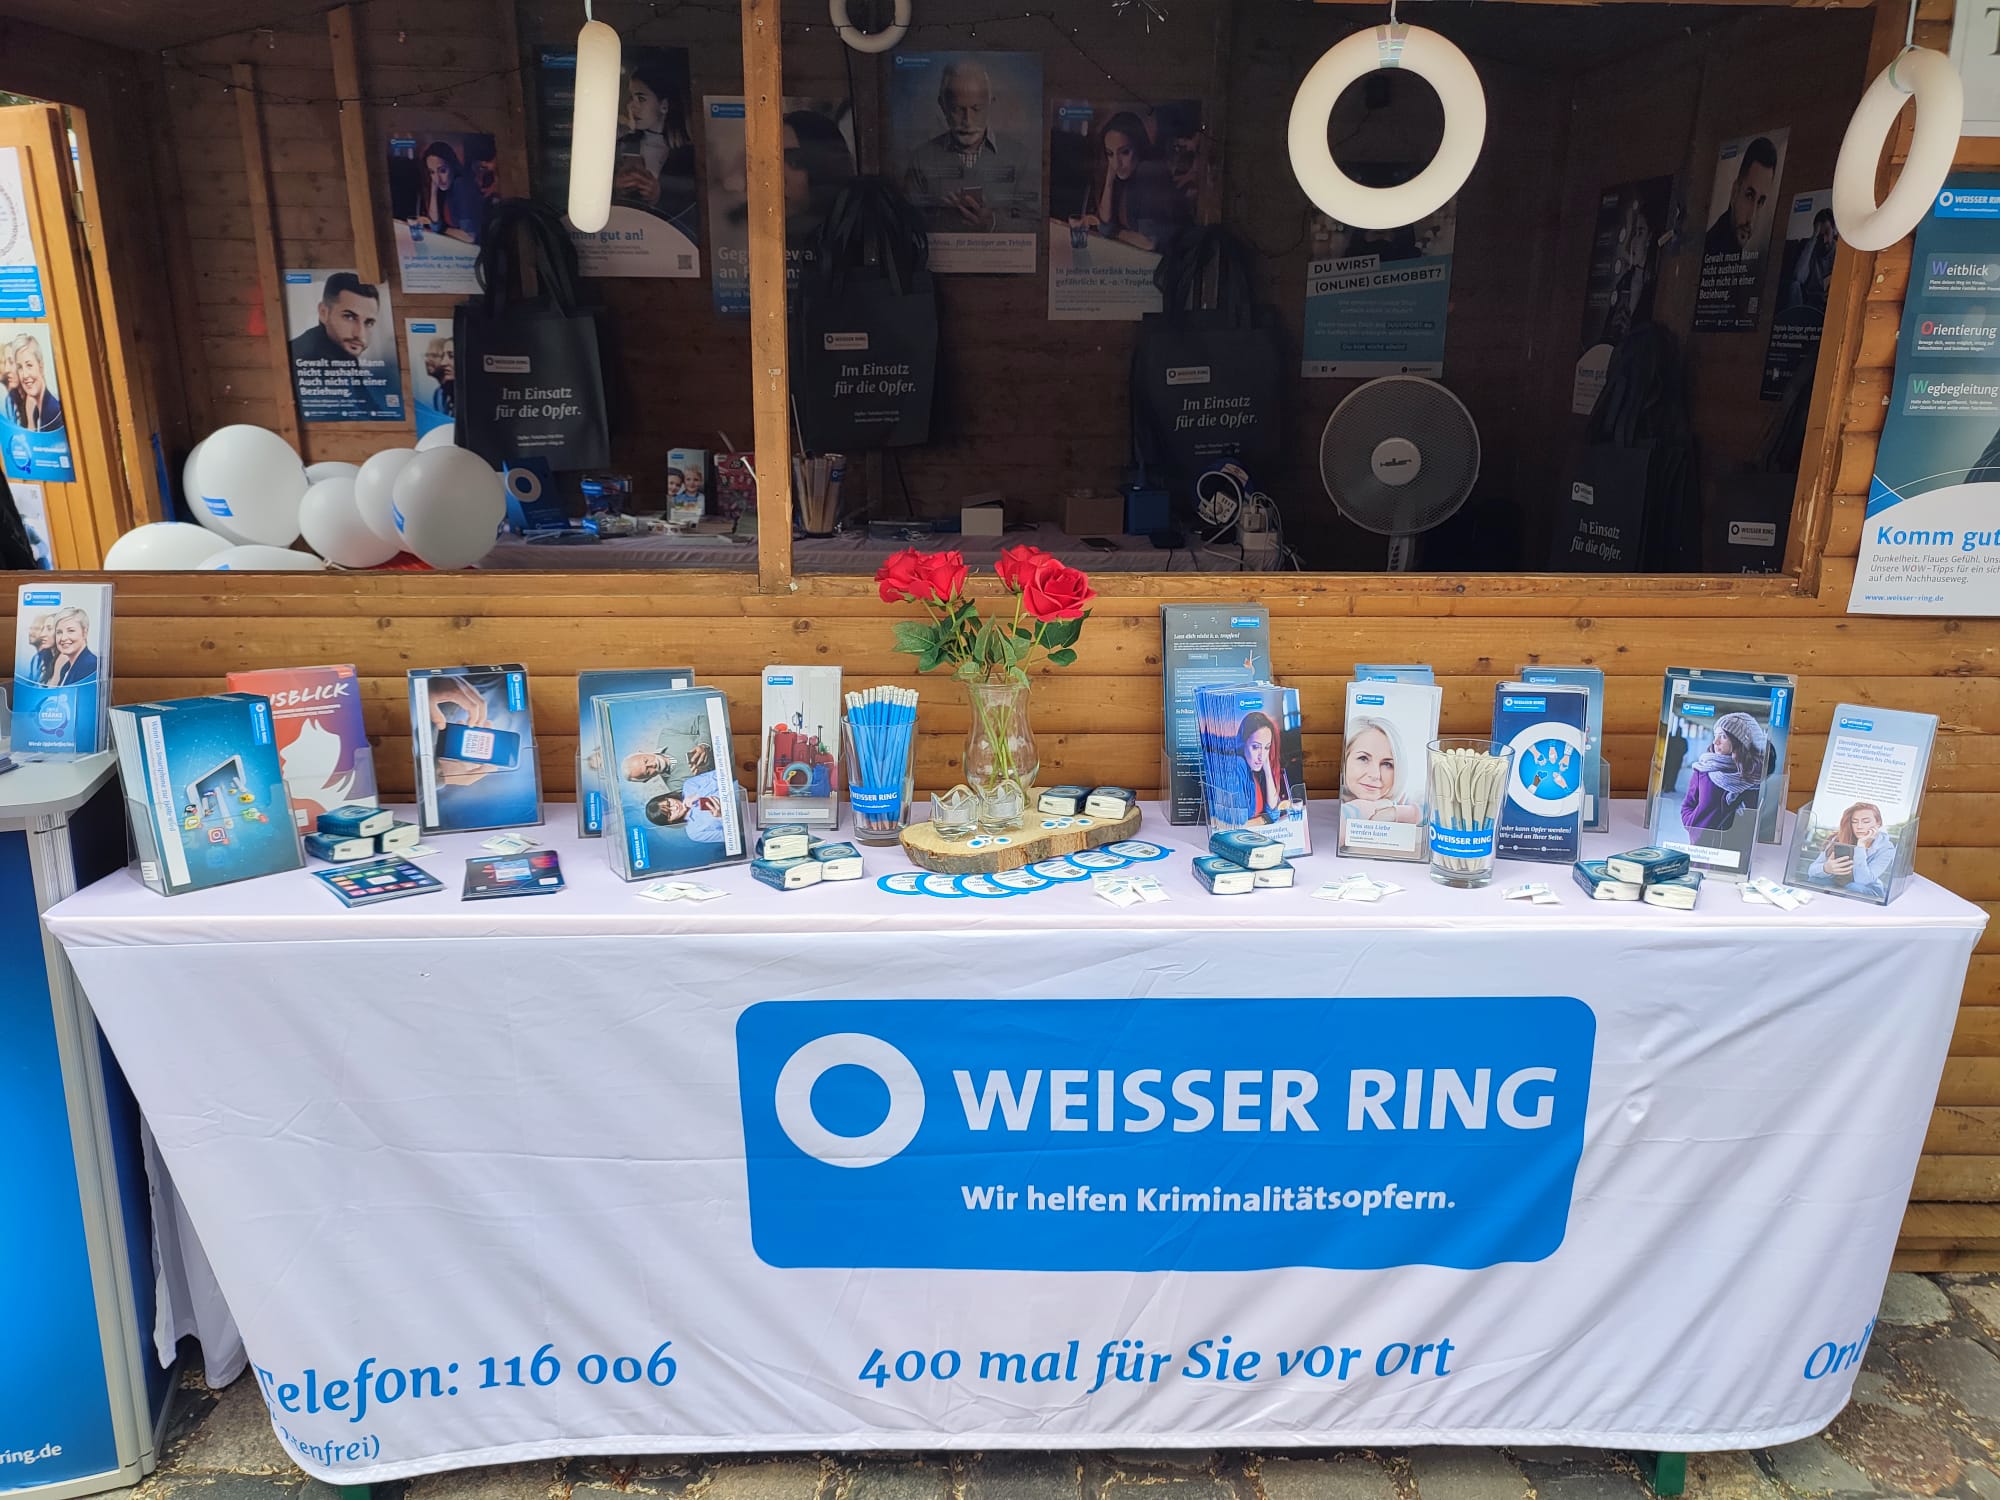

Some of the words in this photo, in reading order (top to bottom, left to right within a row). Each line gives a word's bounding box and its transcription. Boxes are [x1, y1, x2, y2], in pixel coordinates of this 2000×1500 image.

[1956, 195, 1987, 204] WEISSER
[625, 228, 644, 241] an!
[1314, 264, 1332, 274] DU
[1335, 257, 1376, 271] WIRST
[1932, 260, 1989, 276] Weitblick
[1315, 278, 1370, 294] (ONLINE)
[1373, 268, 1442, 286] GEMOBBT?
[1921, 321, 1998, 339] Orientierung
[295, 358, 329, 368] Gewalt
[331, 359, 356, 367] muss
[358, 358, 385, 367] Mann
[841, 365, 859, 377] Im
[862, 363, 910, 376] Einsatz
[297, 368, 323, 377] nicht
[324, 368, 374, 377] aushalten.
[298, 377, 323, 386] Auch
[324, 377, 349, 386] nicht
[351, 378, 361, 386] in
[362, 378, 387, 386] einer
[833, 381, 854, 399] für
[856, 380, 876, 394] die
[879, 379, 917, 396] Opfer.
[1913, 380, 1999, 398] Wegbegleitung
[300, 387, 352, 397] Beziehung.
[502, 388, 521, 401] Im
[524, 387, 572, 401] Einsatz
[1183, 399, 1200, 411] Im
[1203, 396, 1251, 410] Einsatz
[494, 404, 516, 421] für
[518, 404, 539, 418] die
[542, 403, 582, 420] Opfer.
[1174, 415, 1195, 432] für
[1197, 413, 1217, 428] die
[1220, 411, 1258, 429] Opfer.
[1589, 521, 1621, 540] Einsatz
[1877, 526, 1954, 546] Komm
[1961, 529, 2000, 552] gut
[1569, 535, 1585, 553] für
[1585, 538, 1599, 554] die
[1598, 542, 1622, 562] Opfer.
[1872, 554, 1920, 563] Dunkelheit.
[1922, 554, 1949, 563] Flaues
[1951, 555, 1981, 564] Gefühl.
[1870, 564, 1899, 573] Unsere
[1902, 564, 1954, 575] WOW-Tipps
[1956, 565, 1969, 573] für
[1868, 574, 1883, 582] auf
[1885, 574, 1903, 582] dem
[1905, 574, 1969, 585] Nachhauseweg.
[1865, 594, 1945, 603] www.weisser-ring.de
[878, 791, 898, 801] RING
[1530, 826, 1548, 834] Opfer
[1548, 826, 1572, 834] werden!
[1437, 833, 1471, 845] WEISSER
[1472, 834, 1493, 844] RING
[953, 1069, 1319, 1132] WEISSER
[1348, 1067, 1556, 1131] RING
[961, 1186, 1019, 1210] Wir
[1027, 1185, 1127, 1211] helfen
[1137, 1184, 1455, 1216] Kriminalitätsopfern.
[858, 1348, 962, 1390] 400
[978, 1339, 1081, 1385] mal
[1088, 1335, 1173, 1395] für
[1181, 1334, 1262, 1383] Sie
[1276, 1344, 1363, 1382] vor
[253, 1357, 460, 1424] Telefon:
[479, 1343, 562, 1390] 116
[576, 1340, 678, 1388] 006
